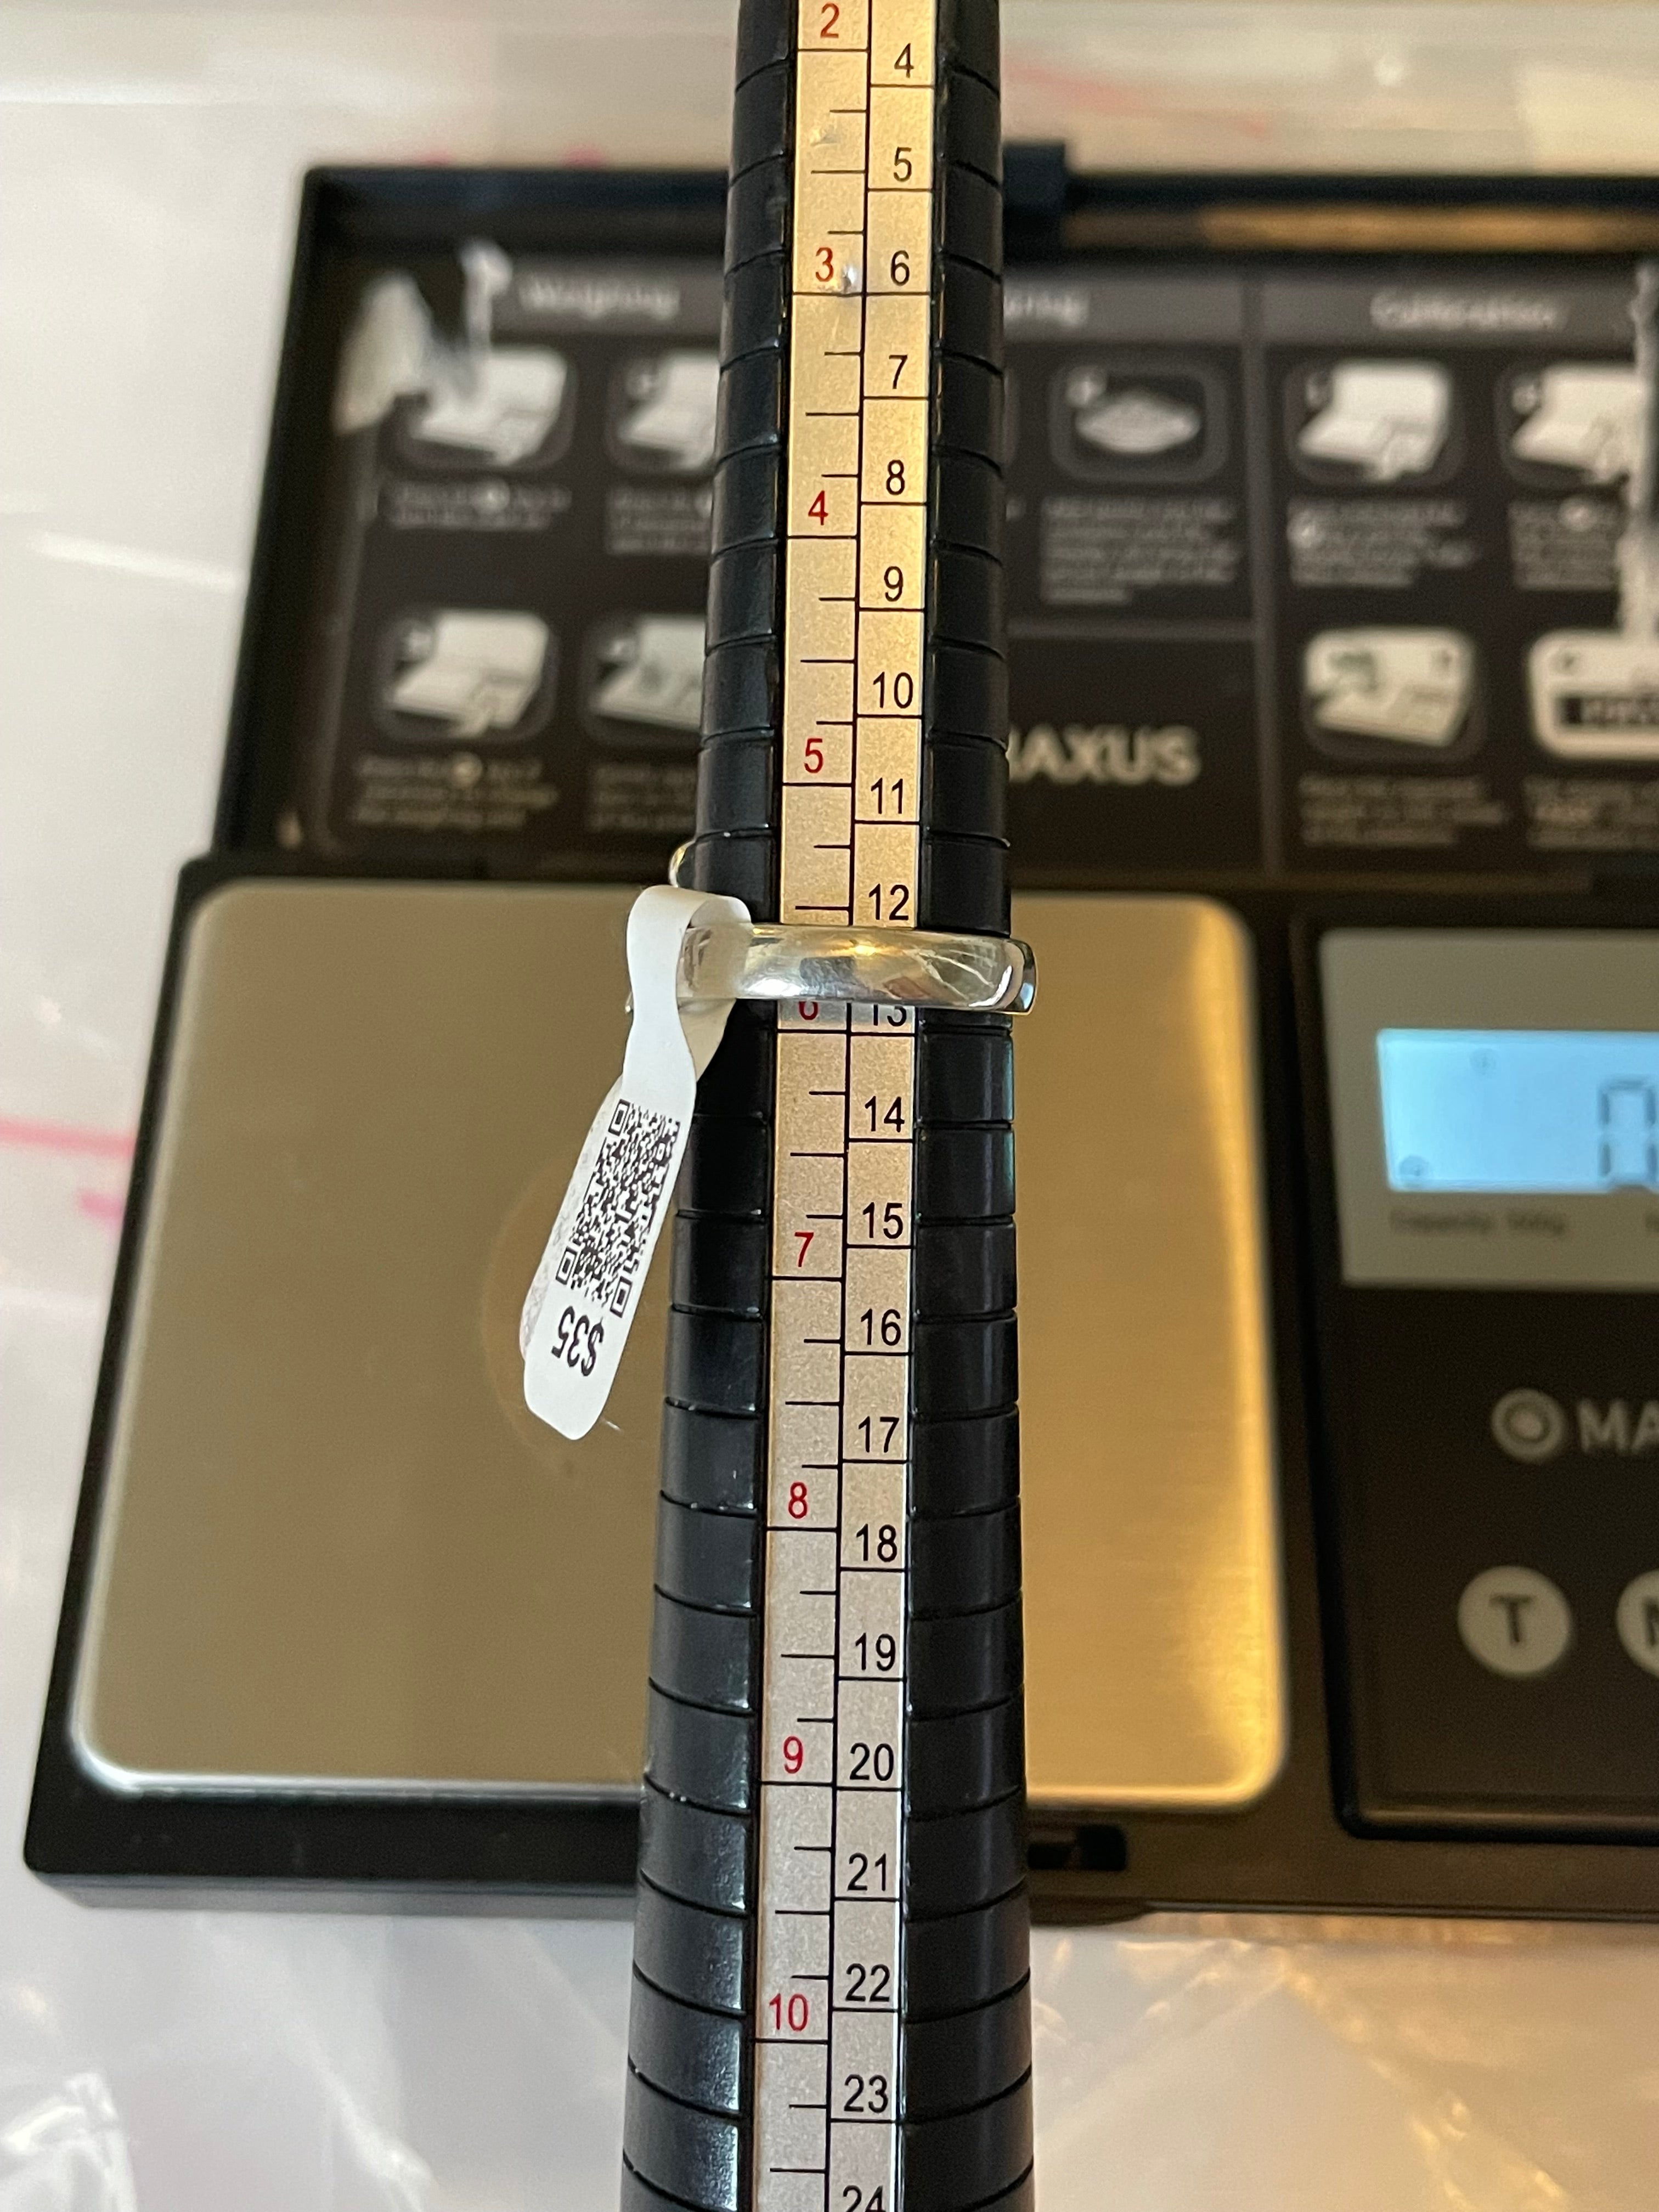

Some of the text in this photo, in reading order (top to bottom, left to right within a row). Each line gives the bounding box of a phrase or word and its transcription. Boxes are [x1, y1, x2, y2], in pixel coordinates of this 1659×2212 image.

[820, 3, 840, 38] 2
[894, 43, 914, 78] 4
[893, 146, 912, 182] 5
[815, 247, 834, 283] 3
[890, 250, 910, 286] 6
[889, 354, 907, 390] 7
[886, 460, 905, 496] 8
[808, 490, 829, 526] 4
[884, 566, 904, 602] 9
[873, 672, 913, 709] 10
[804, 737, 824, 775] 5
[871, 777, 903, 815] 11
[868, 883, 909, 921] 12
[865, 1096, 905, 1133] 14
[862, 1201, 904, 1239] 15
[794, 1231, 814, 1267] 7
[551, 1306, 603, 1378] $35
[860, 1308, 901, 1346] 16
[858, 1415, 900, 1454] 17
[788, 1481, 808, 1519] 8
[856, 1523, 898, 1563] 18
[1489, 1593, 1533, 1644] T
[855, 1632, 896, 1672] 19
[783, 1736, 804, 1774] 9
[849, 1742, 894, 1781] 20
[847, 1852, 887, 1892] 21
[845, 1963, 890, 2003] 22
[769, 1993, 809, 2032] 10
[843, 2074, 889, 2114] 23
